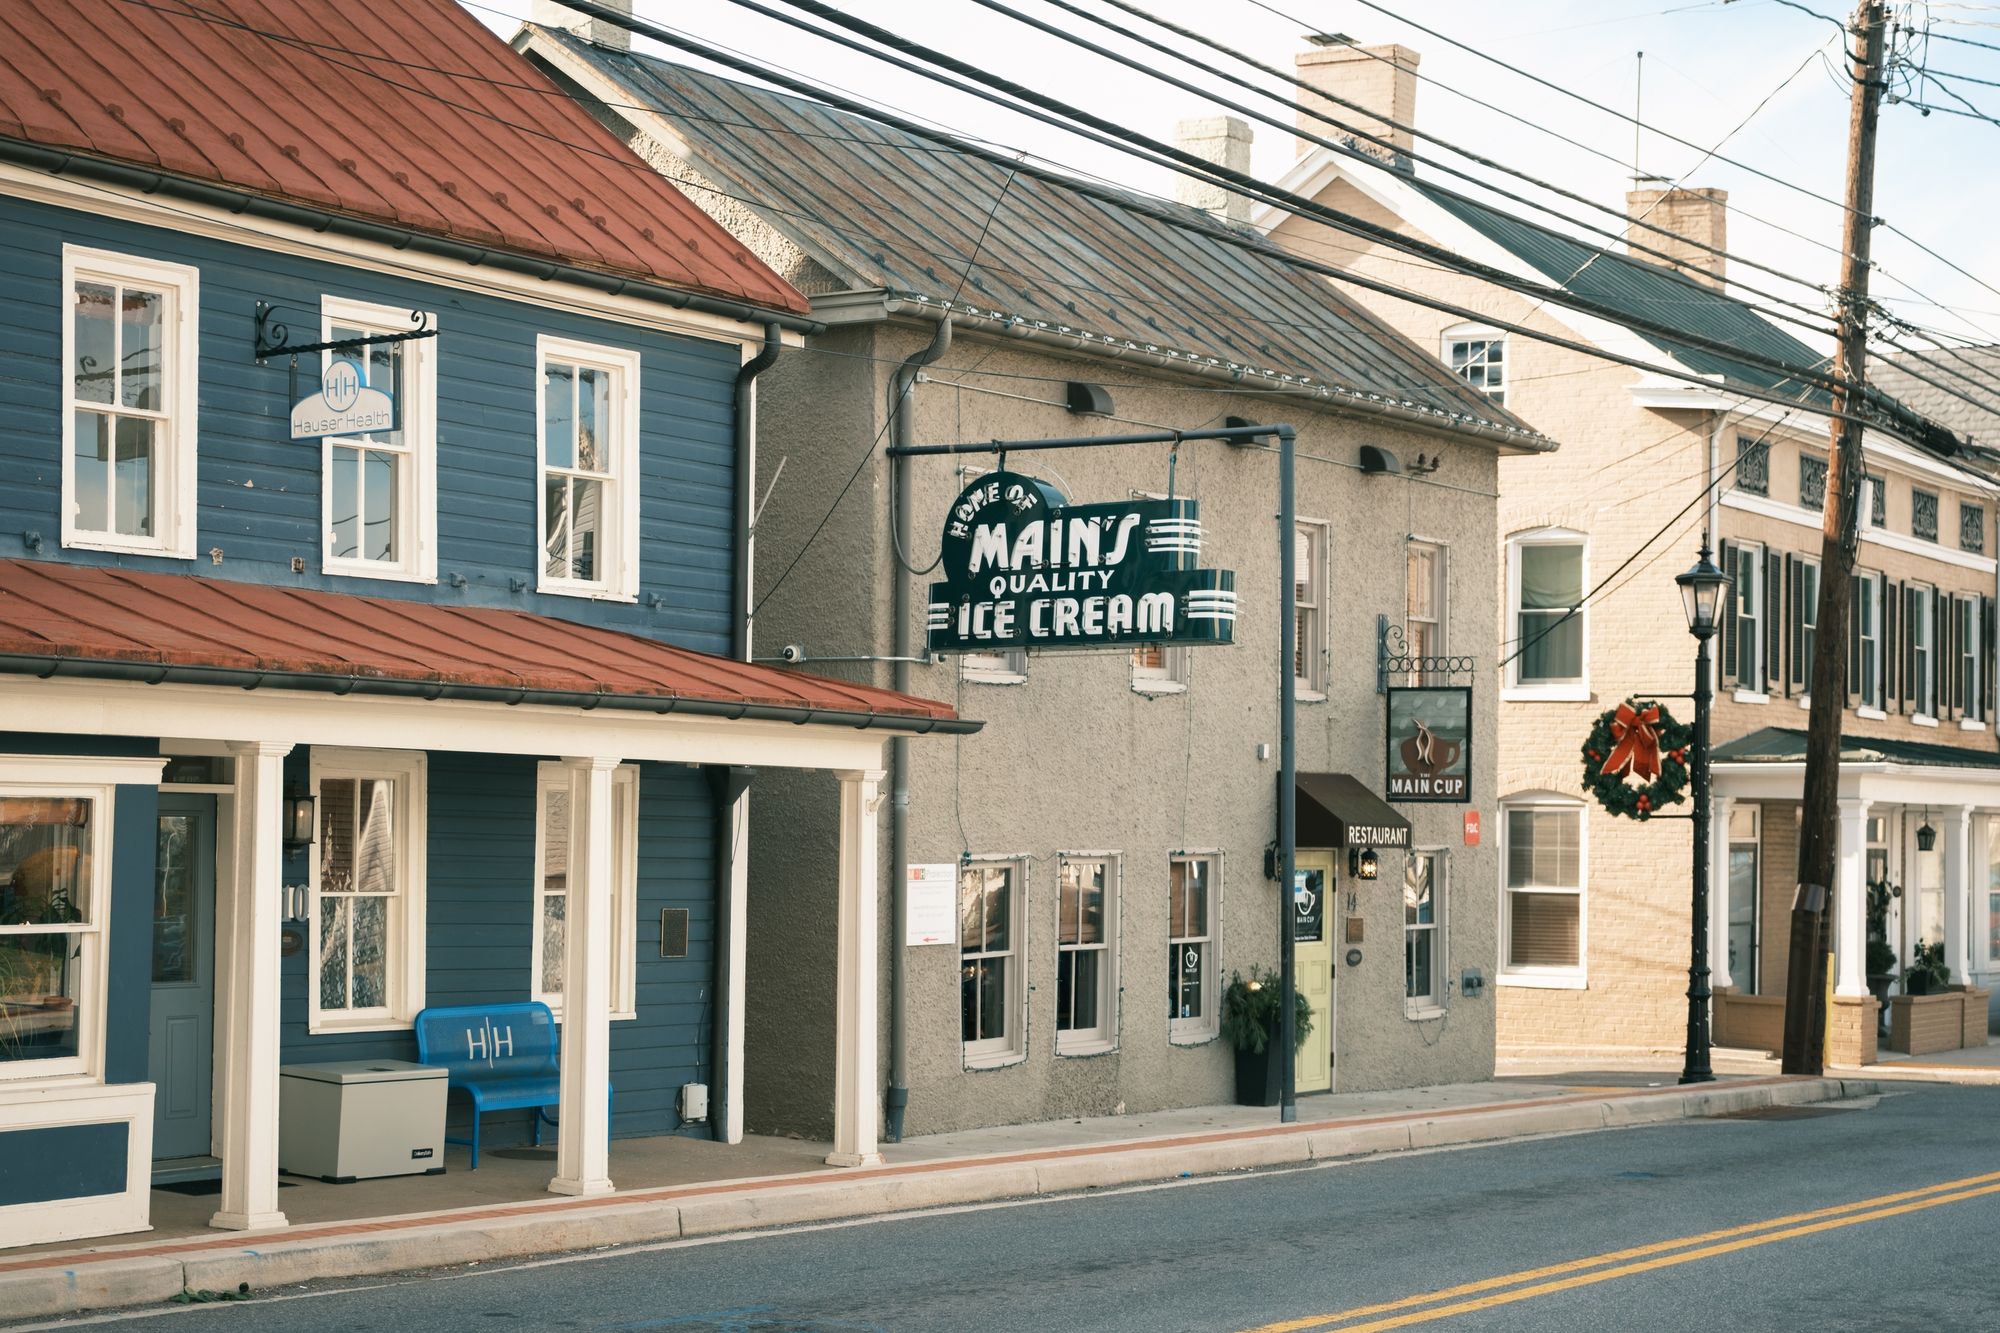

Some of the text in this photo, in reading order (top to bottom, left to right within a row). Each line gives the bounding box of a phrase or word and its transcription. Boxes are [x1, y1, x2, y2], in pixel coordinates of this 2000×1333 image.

[293, 410, 390, 434] Hauser Health
[950, 482, 1038, 539] HOME OF
[968, 513, 1141, 573] MAIN'S
[989, 570, 1114, 599] QUALITY
[957, 592, 1175, 640] ICE CREAM
[1391, 778, 1463, 794] MAIN CUP
[1348, 825, 1408, 845] RESTAURANT
